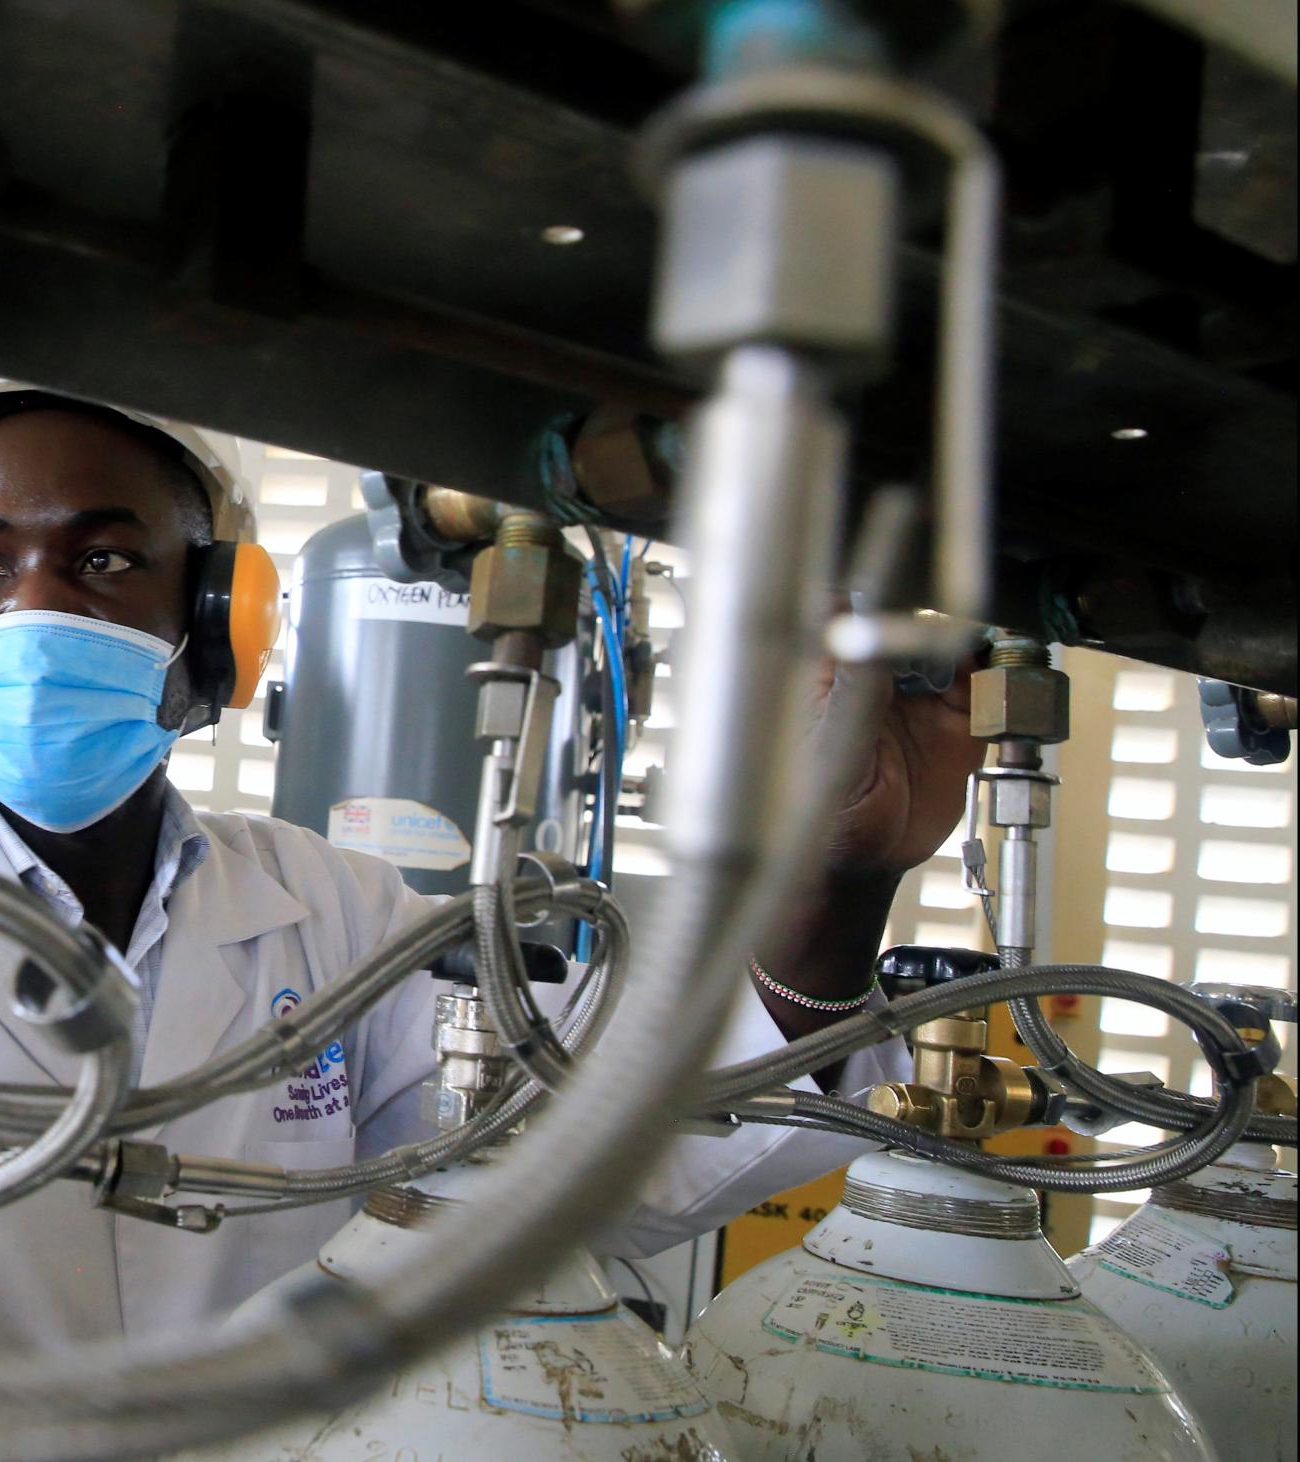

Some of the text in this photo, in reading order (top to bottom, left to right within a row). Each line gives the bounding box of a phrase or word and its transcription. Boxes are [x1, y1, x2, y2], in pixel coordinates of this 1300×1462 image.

[368, 584, 432, 606] OXYGEN
[311, 1074, 348, 1100] Lives
[273, 1106, 294, 1123] One
[325, 1097, 342, 1115] at
